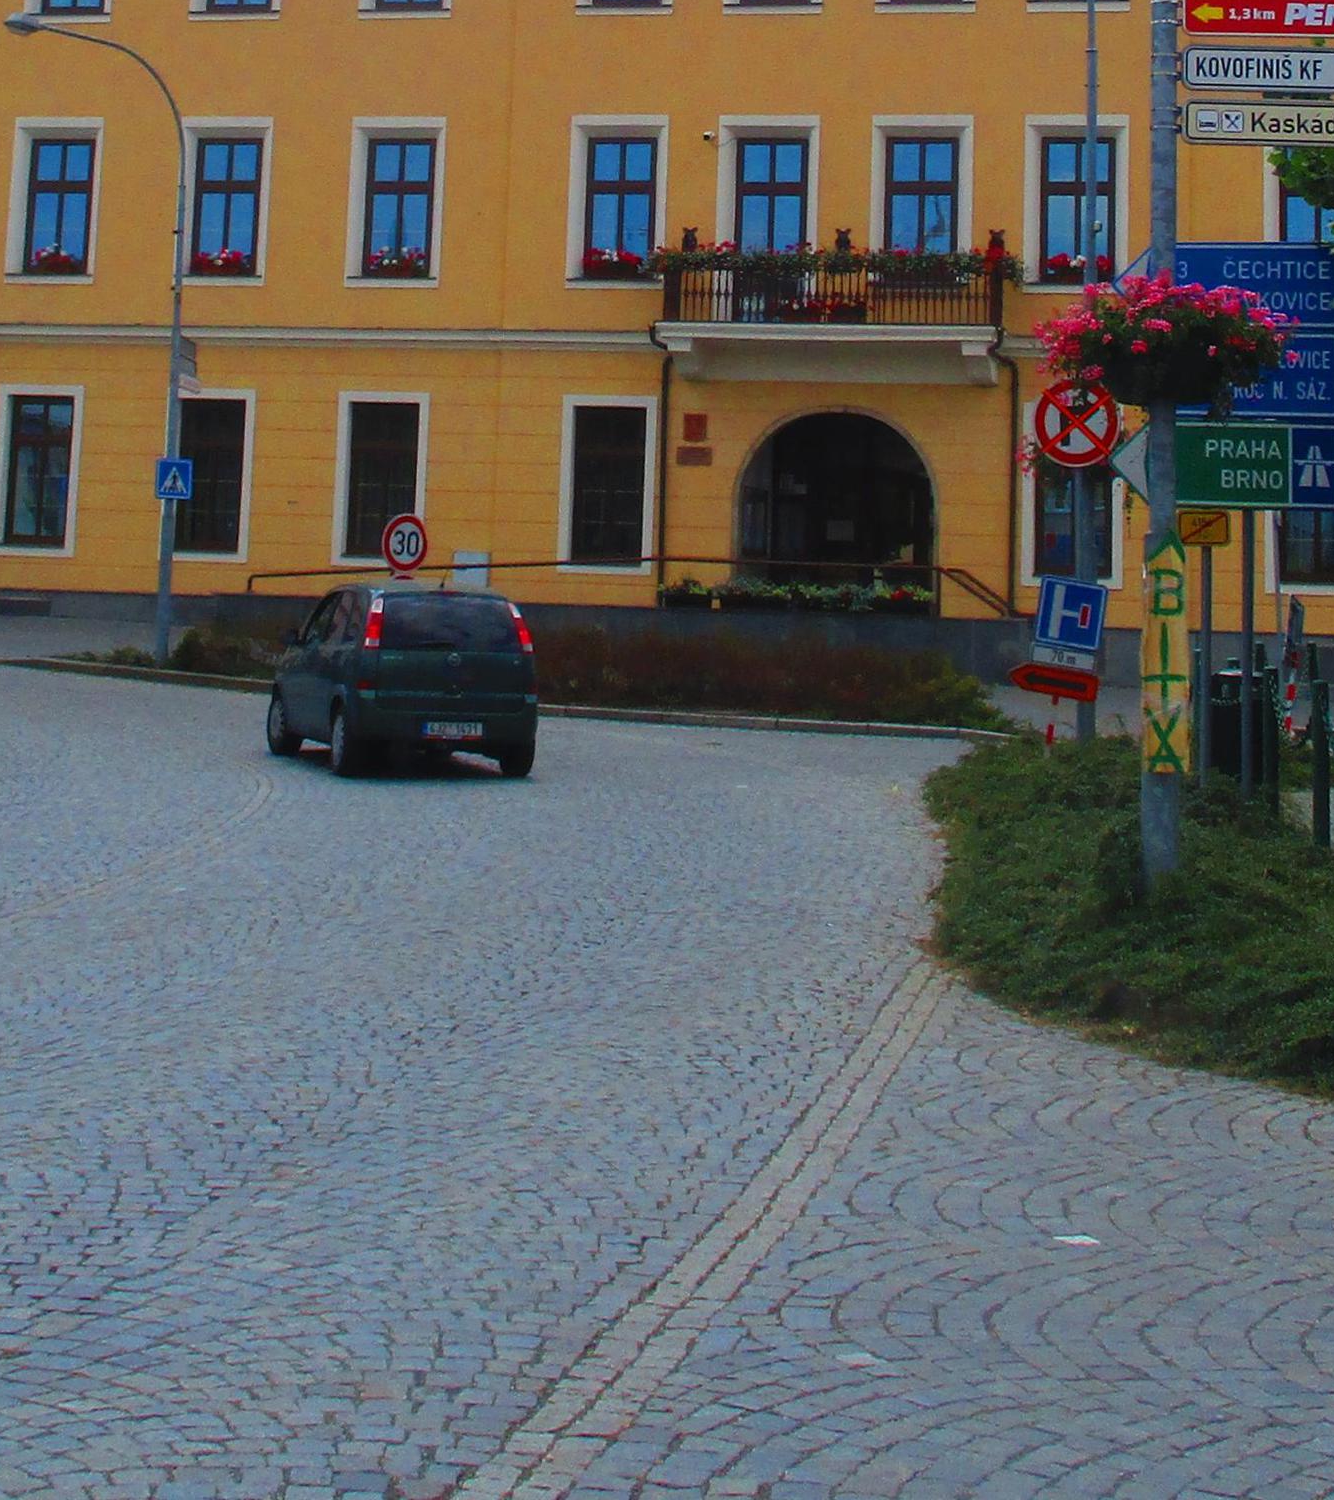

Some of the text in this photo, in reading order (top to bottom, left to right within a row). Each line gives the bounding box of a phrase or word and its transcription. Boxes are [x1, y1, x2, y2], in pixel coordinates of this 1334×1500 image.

[1228, 8, 1252, 20] 1,3
[1253, 7, 1276, 20] km
[1196, 54, 1323, 81] KOVOFINIŠ KF
[1223, 256, 1331, 280] ČECHTICE
[1296, 377, 1331, 400] SÁZ.
[1205, 439, 1283, 459] PRAHA
[1220, 469, 1283, 490] BRNO
[392, 530, 420, 557] 30
[1050, 650, 1065, 662] 70
